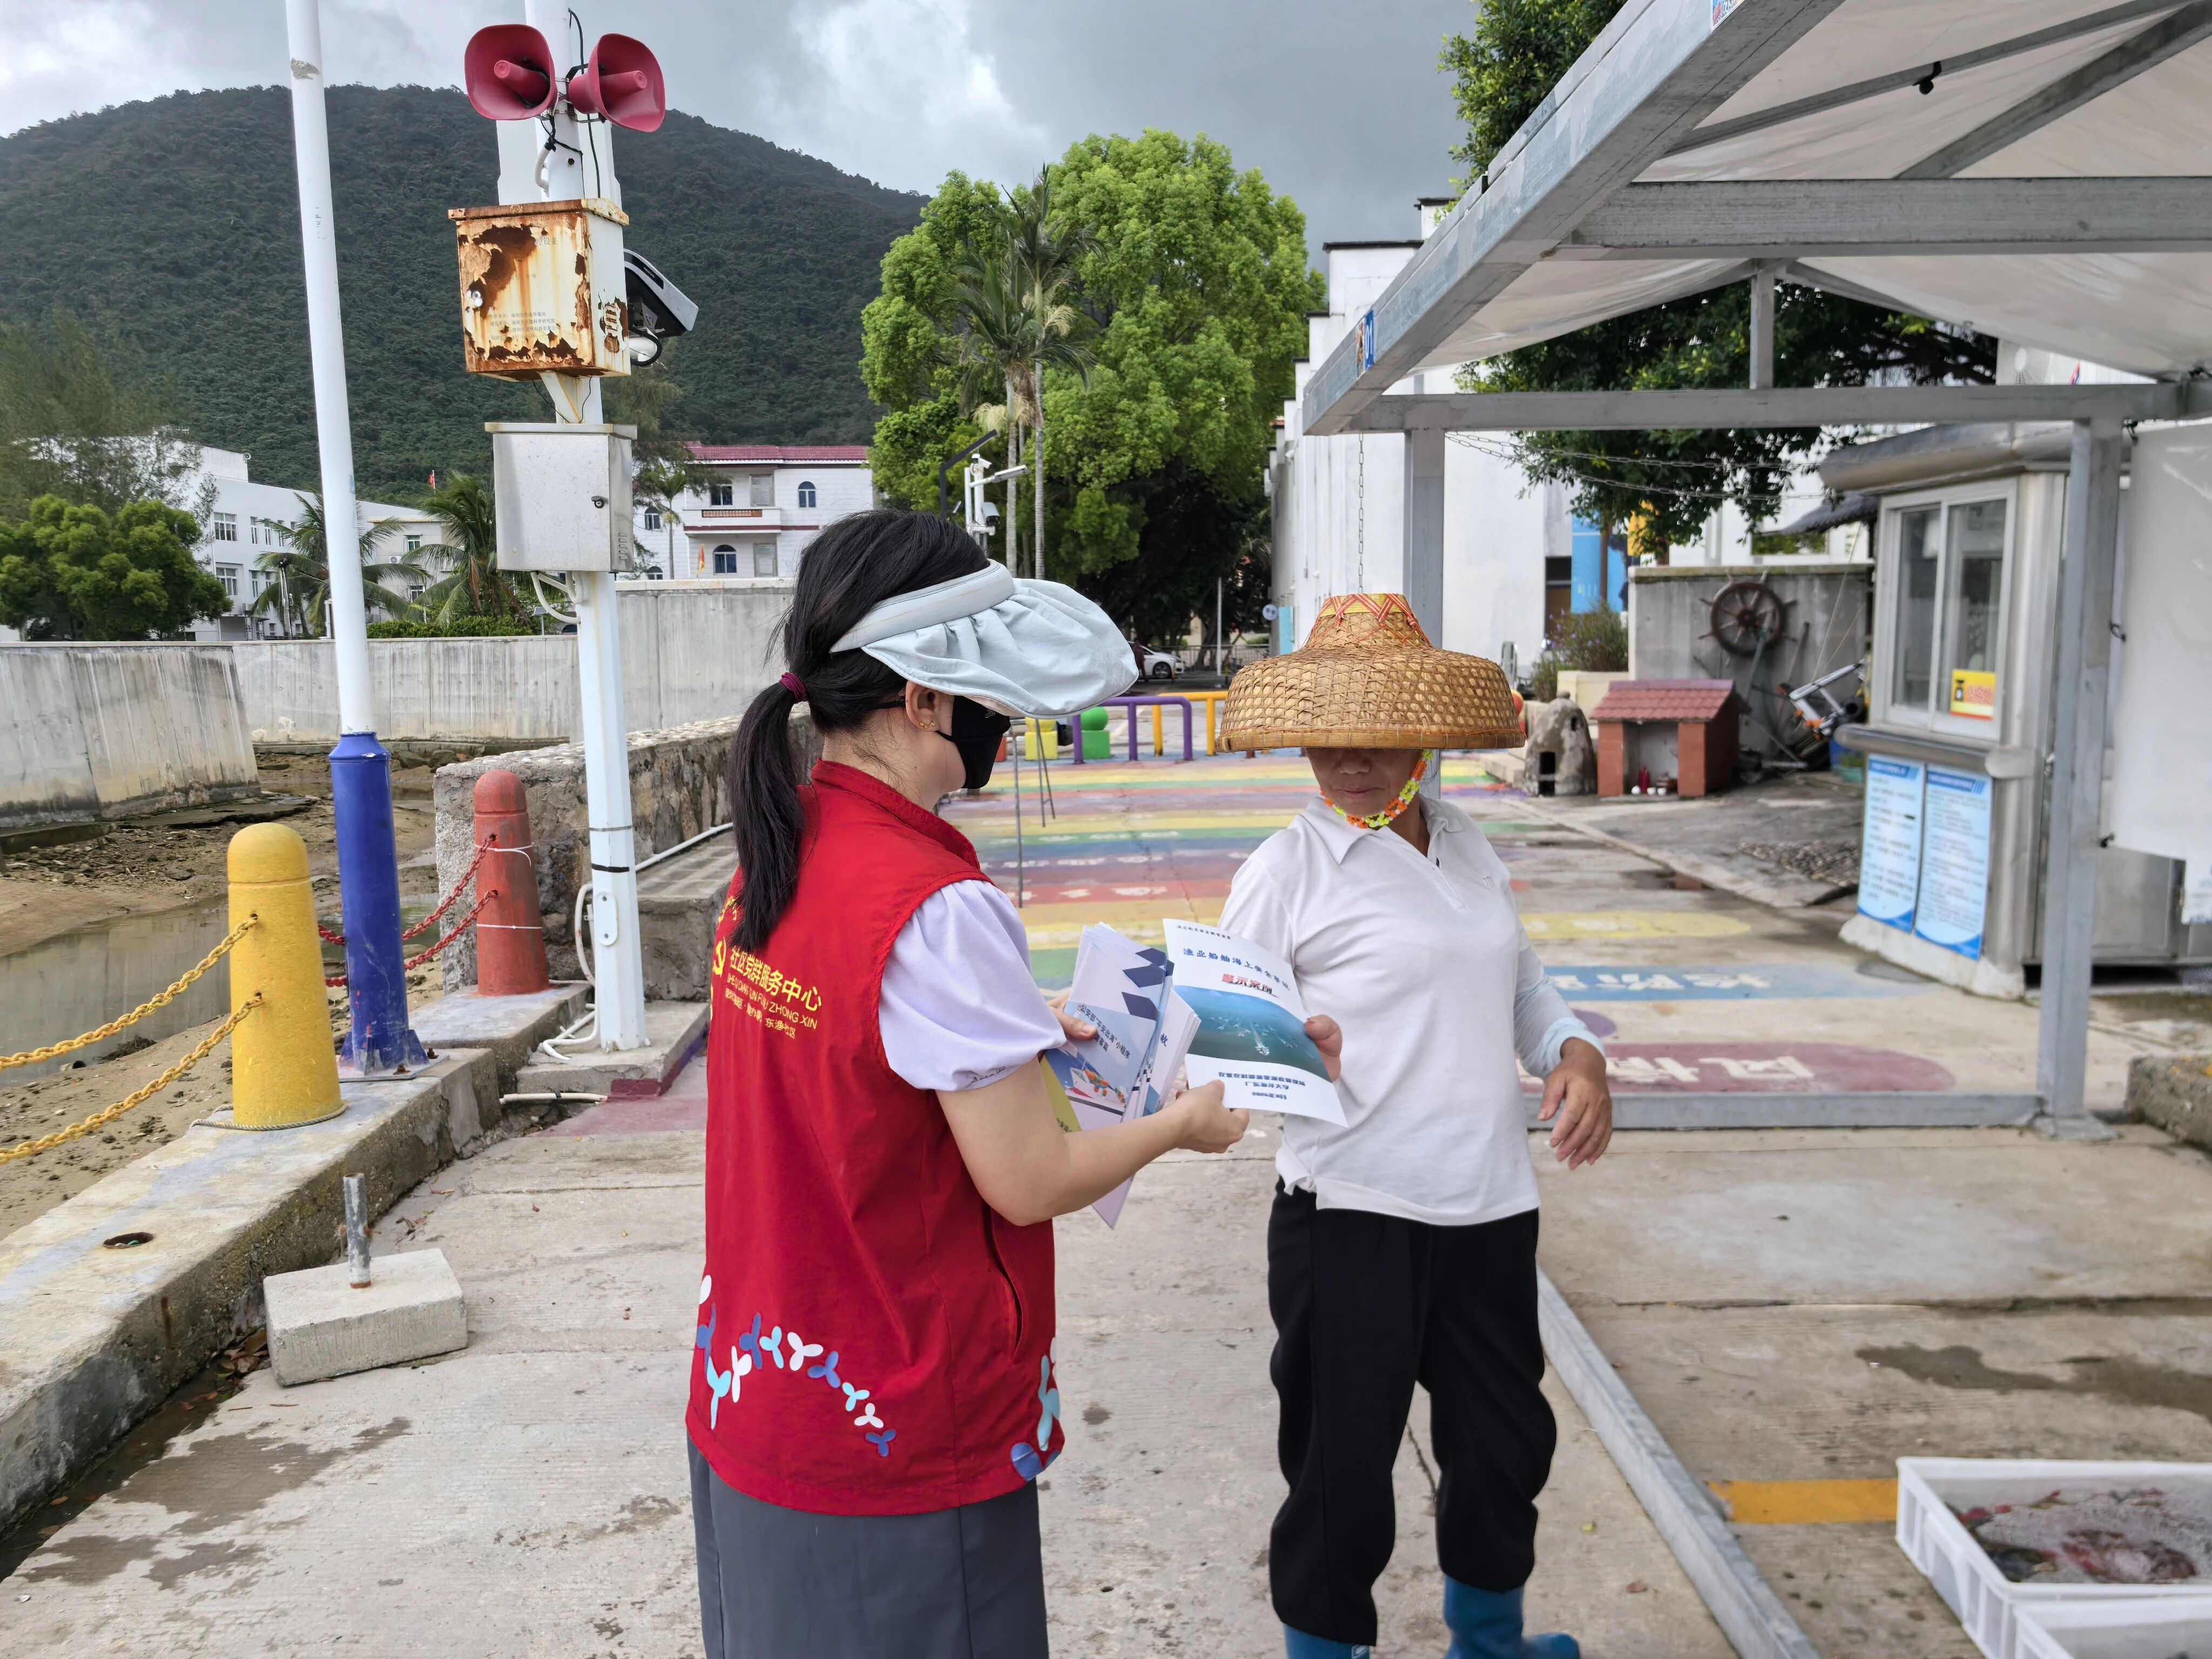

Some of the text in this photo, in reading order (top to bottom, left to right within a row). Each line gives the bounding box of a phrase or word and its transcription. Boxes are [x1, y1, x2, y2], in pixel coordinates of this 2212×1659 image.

[730, 946, 822, 1011] 社区党群服务中心
[1183, 948, 1290, 990] 渔业船舶海上安全事故
[1222, 974, 1273, 994] 警示案例
[769, 1001, 799, 1023] ZHONG
[800, 1015, 818, 1029] XIN
